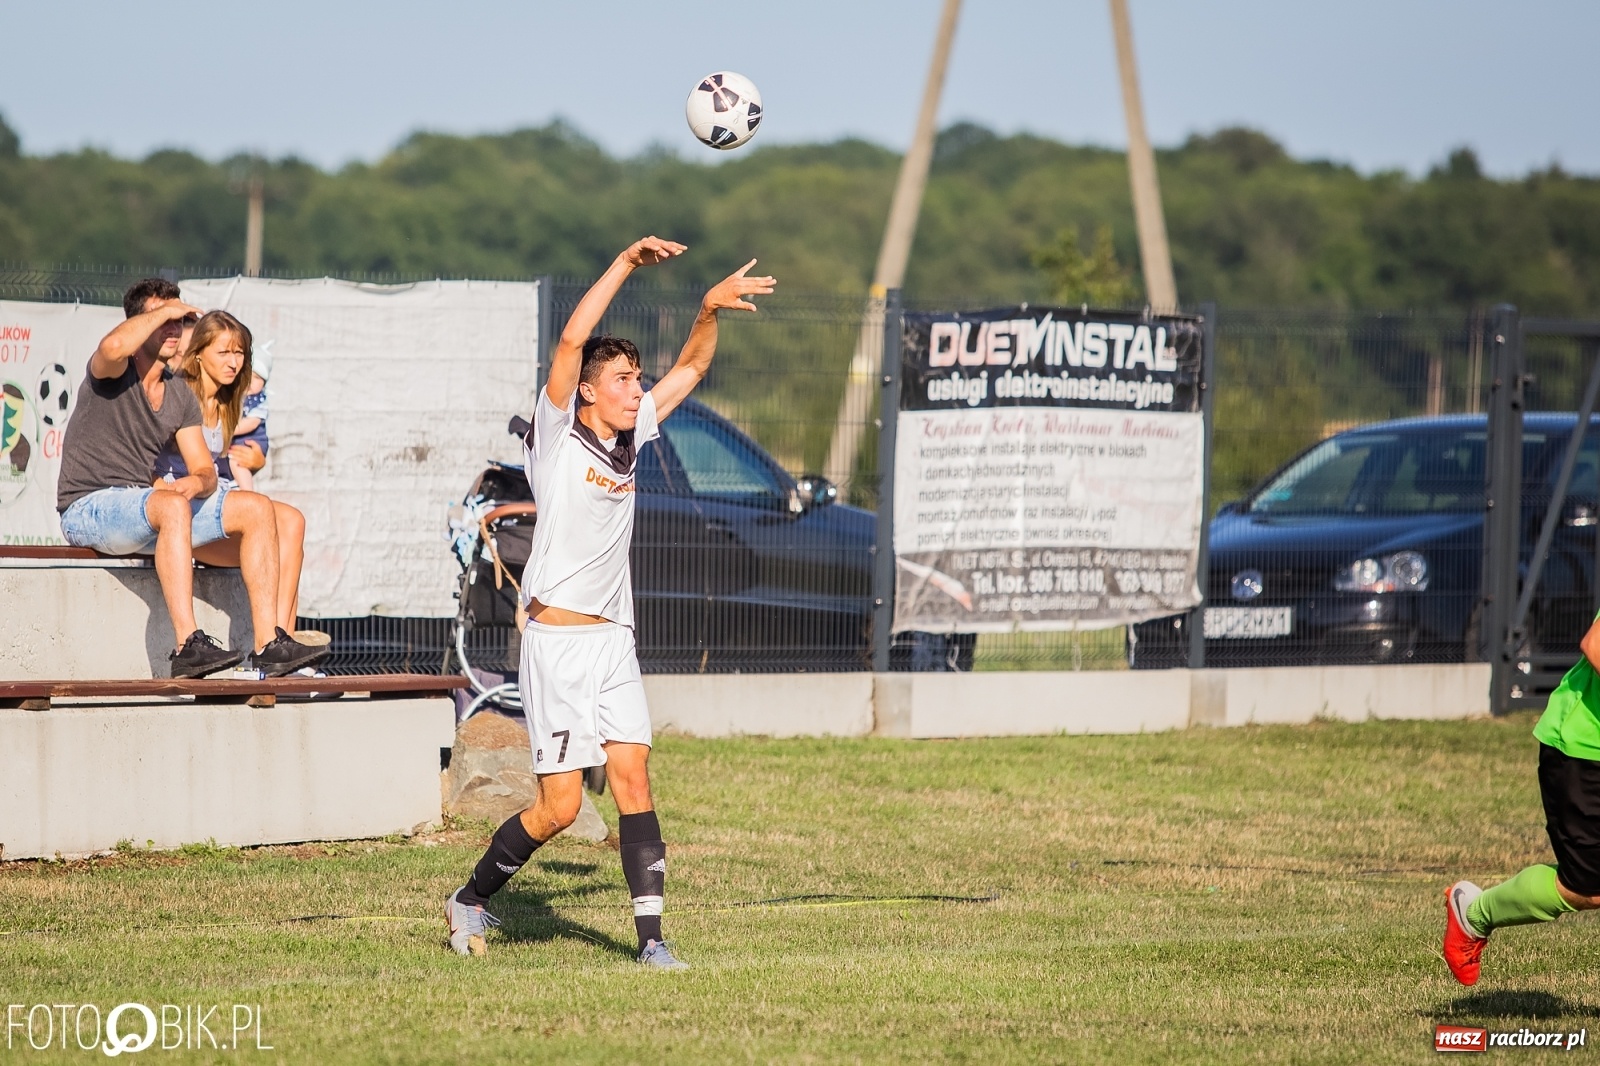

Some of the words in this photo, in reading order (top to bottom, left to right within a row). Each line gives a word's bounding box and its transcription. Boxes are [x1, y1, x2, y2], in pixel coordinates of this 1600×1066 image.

[0, 323, 30, 340] IKÓW
[995, 371, 1174, 408] elektroinstalacyjne
[551, 730, 570, 763] 7
